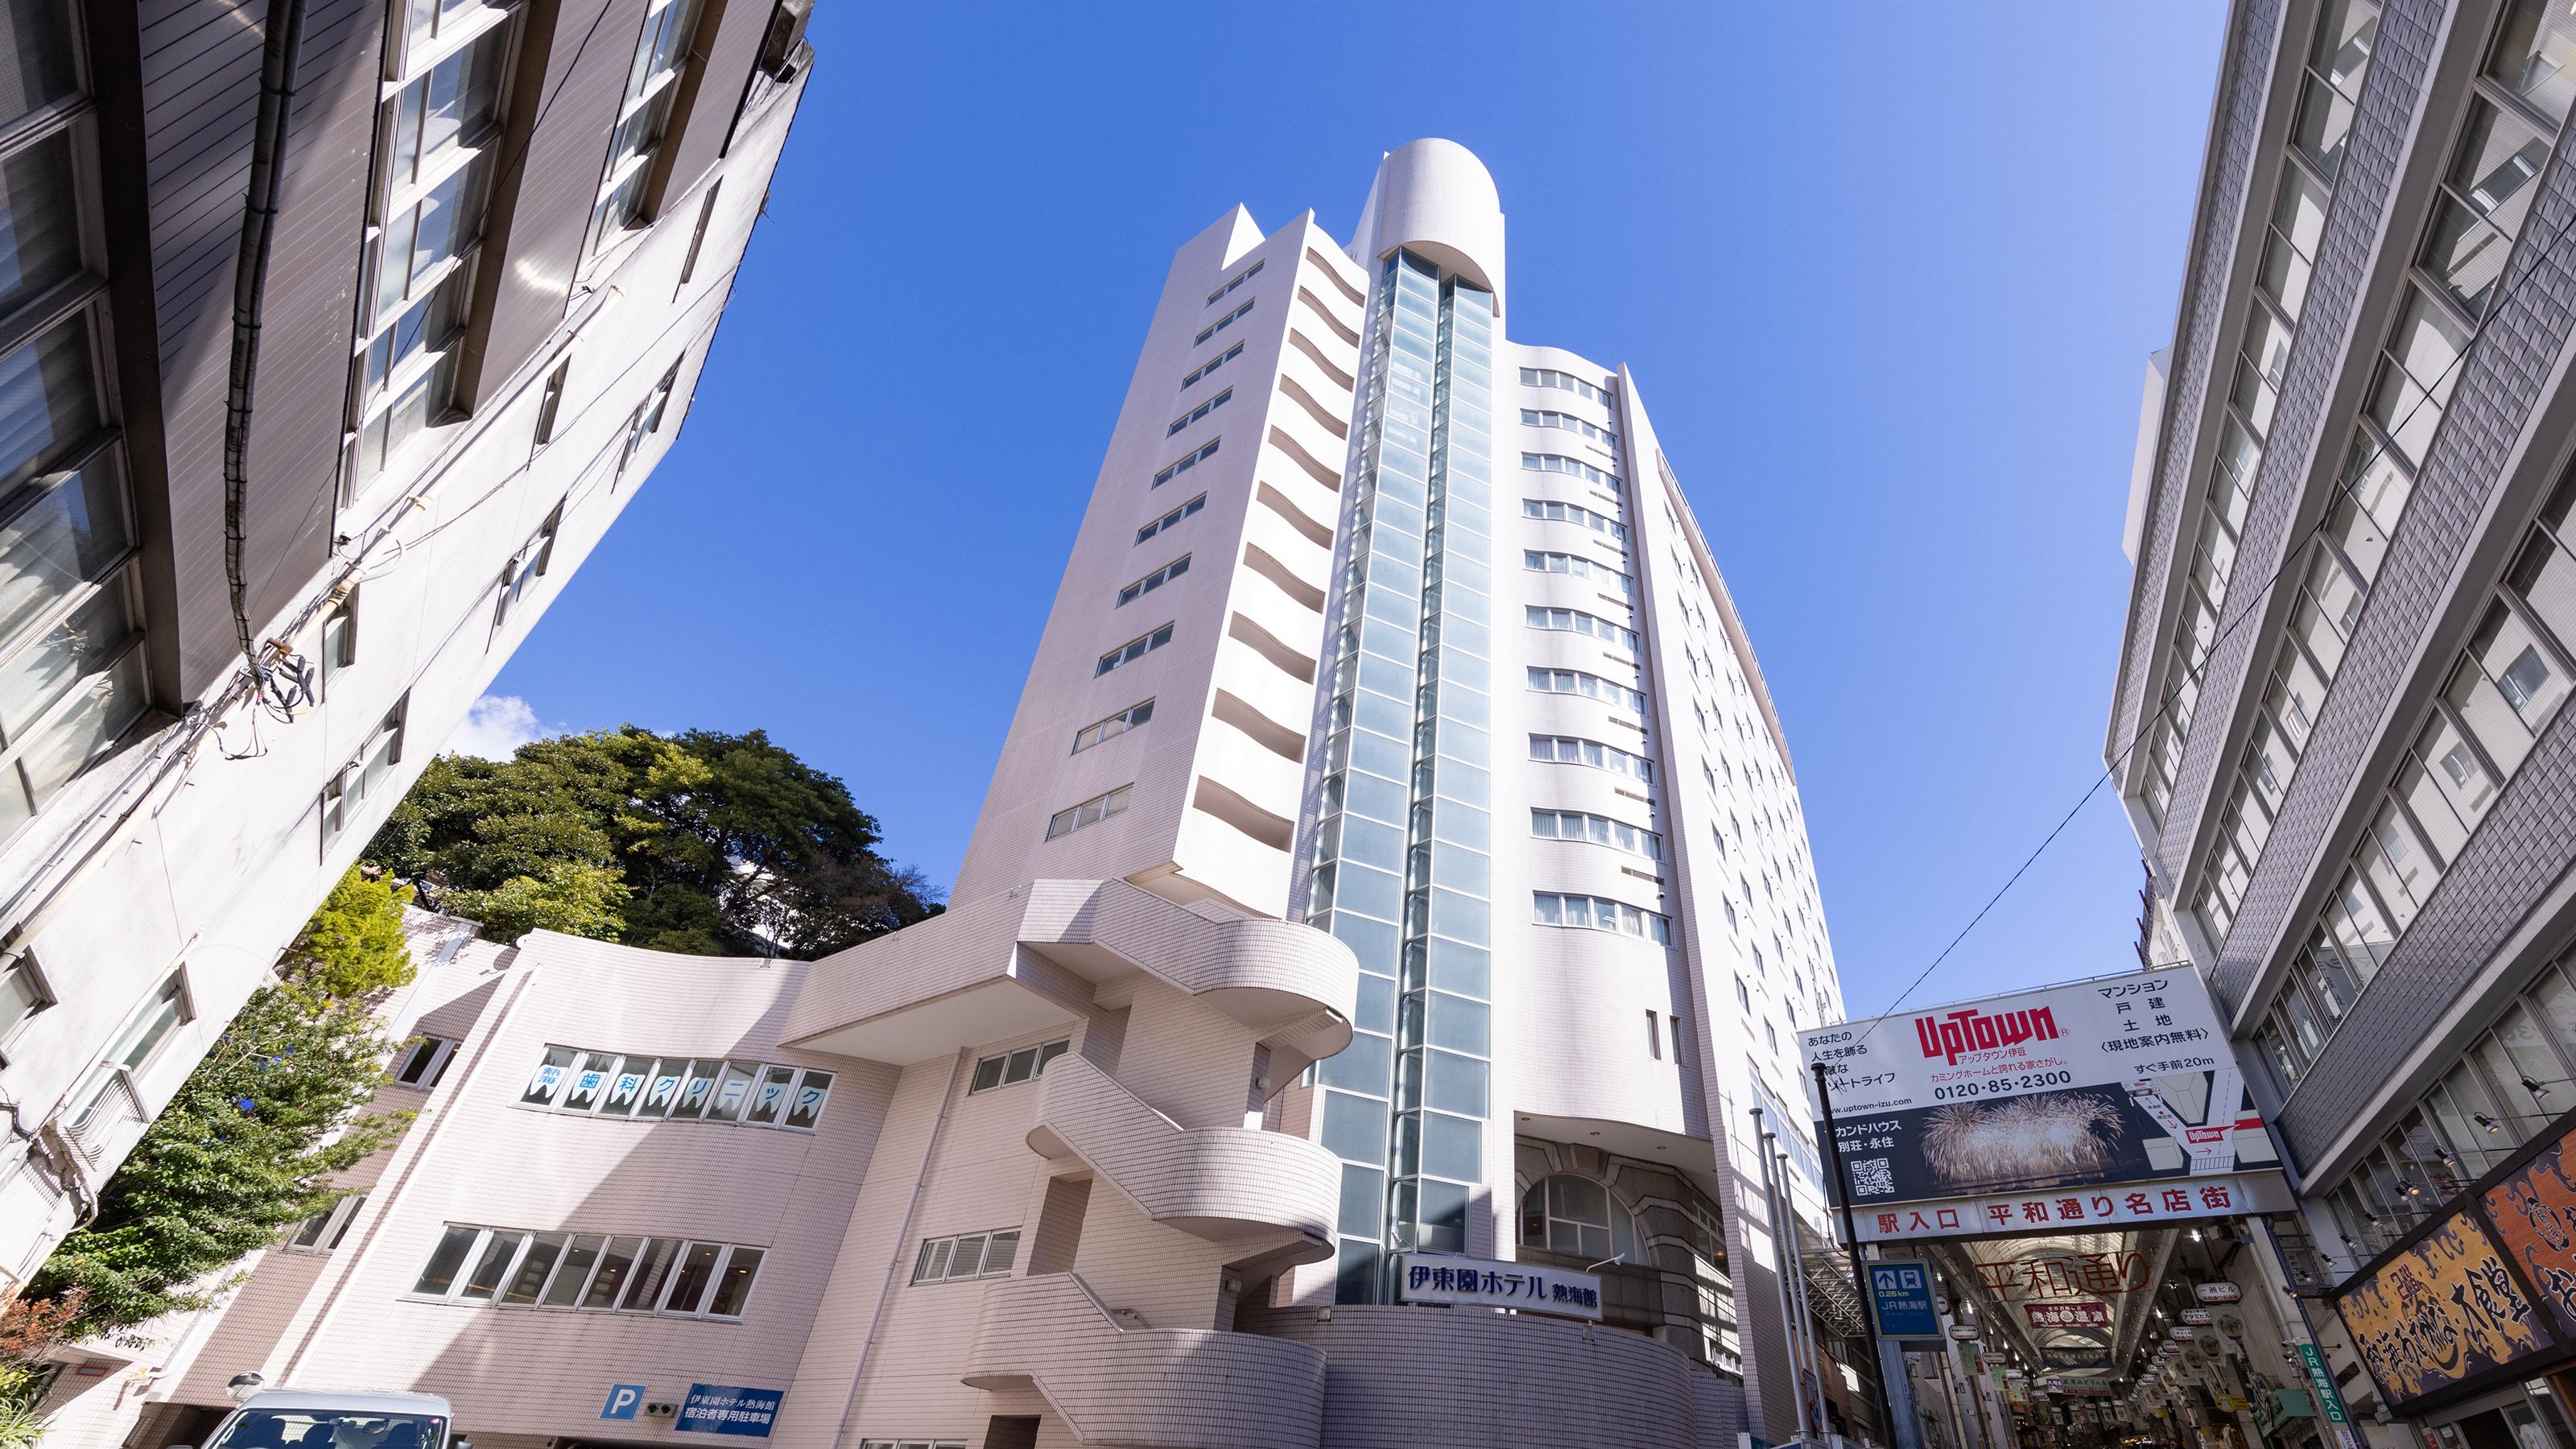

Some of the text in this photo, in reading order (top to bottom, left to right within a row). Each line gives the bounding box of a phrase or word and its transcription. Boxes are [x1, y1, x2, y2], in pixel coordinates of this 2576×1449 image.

[2098, 980, 2169, 999] マンション
[1807, 1031, 1852, 1046] あなたの
[1811, 1045, 1868, 1063] 人生を飾る
[1959, 1046, 2027, 1065] アップタウン伊豆
[1930, 1057, 2068, 1084] カミングホームと誇れる家さがし。
[2134, 1056, 2215, 1075] すぐ手前20m
[1834, 1121, 1902, 1138] カンドハウス
[1838, 1137, 1895, 1154] 別荘・永住
[1877, 1186, 2231, 1235] 駅入口 平和通り名店街
[1974, 1251, 2150, 1302] 平和通り
[1408, 1265, 1598, 1309] 伊東園ホテル 熱海館
[1881, 1300, 1928, 1311] JR熱海駅
[2306, 1346, 2343, 1421] JR熱海駅入口
[610, 1389, 636, 1414] P
[689, 1393, 776, 1411] 伊東園ホテル熱海館
[683, 1406, 773, 1425] 宿泊者専用駐車場
